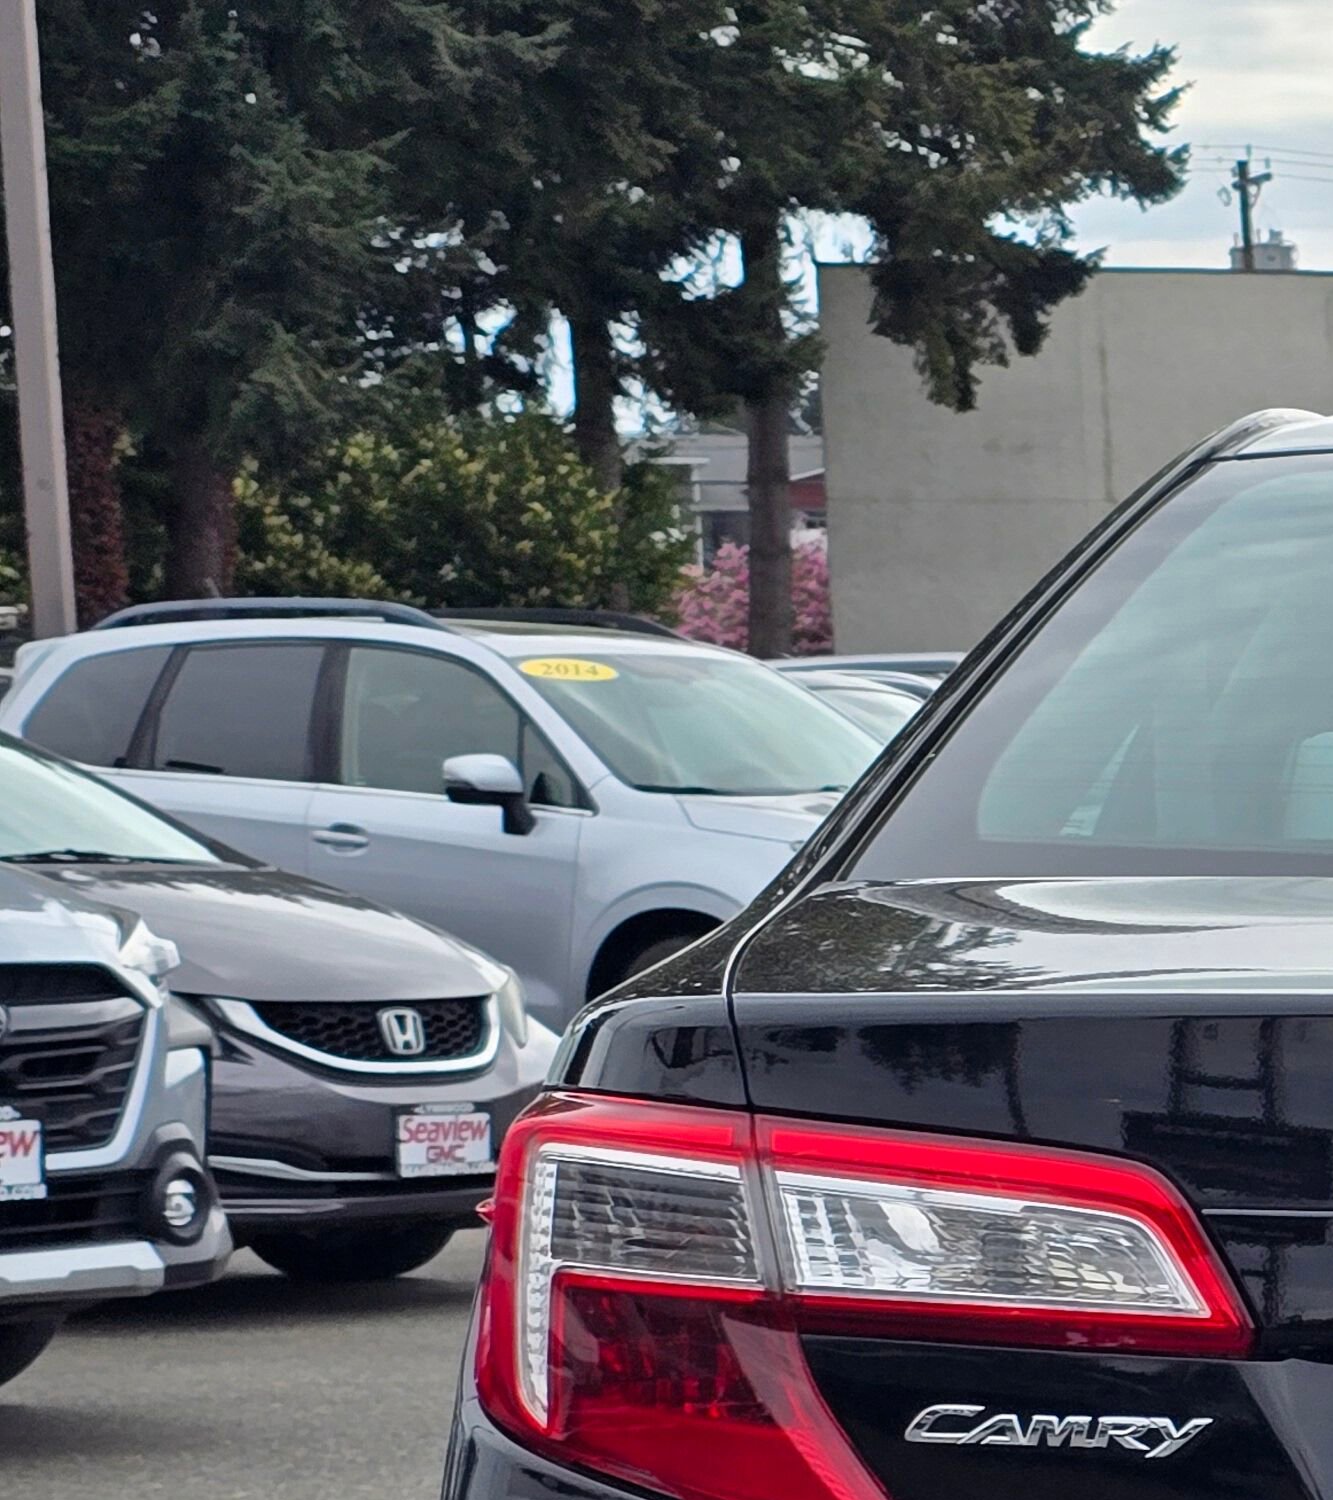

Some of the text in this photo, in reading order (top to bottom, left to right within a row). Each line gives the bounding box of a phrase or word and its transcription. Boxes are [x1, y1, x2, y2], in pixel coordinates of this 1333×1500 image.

[540, 662, 599, 676] 2014
[398, 1118, 490, 1143] Seaview
[426, 1145, 466, 1163] GMC
[904, 1404, 1214, 1459] CAMRY
